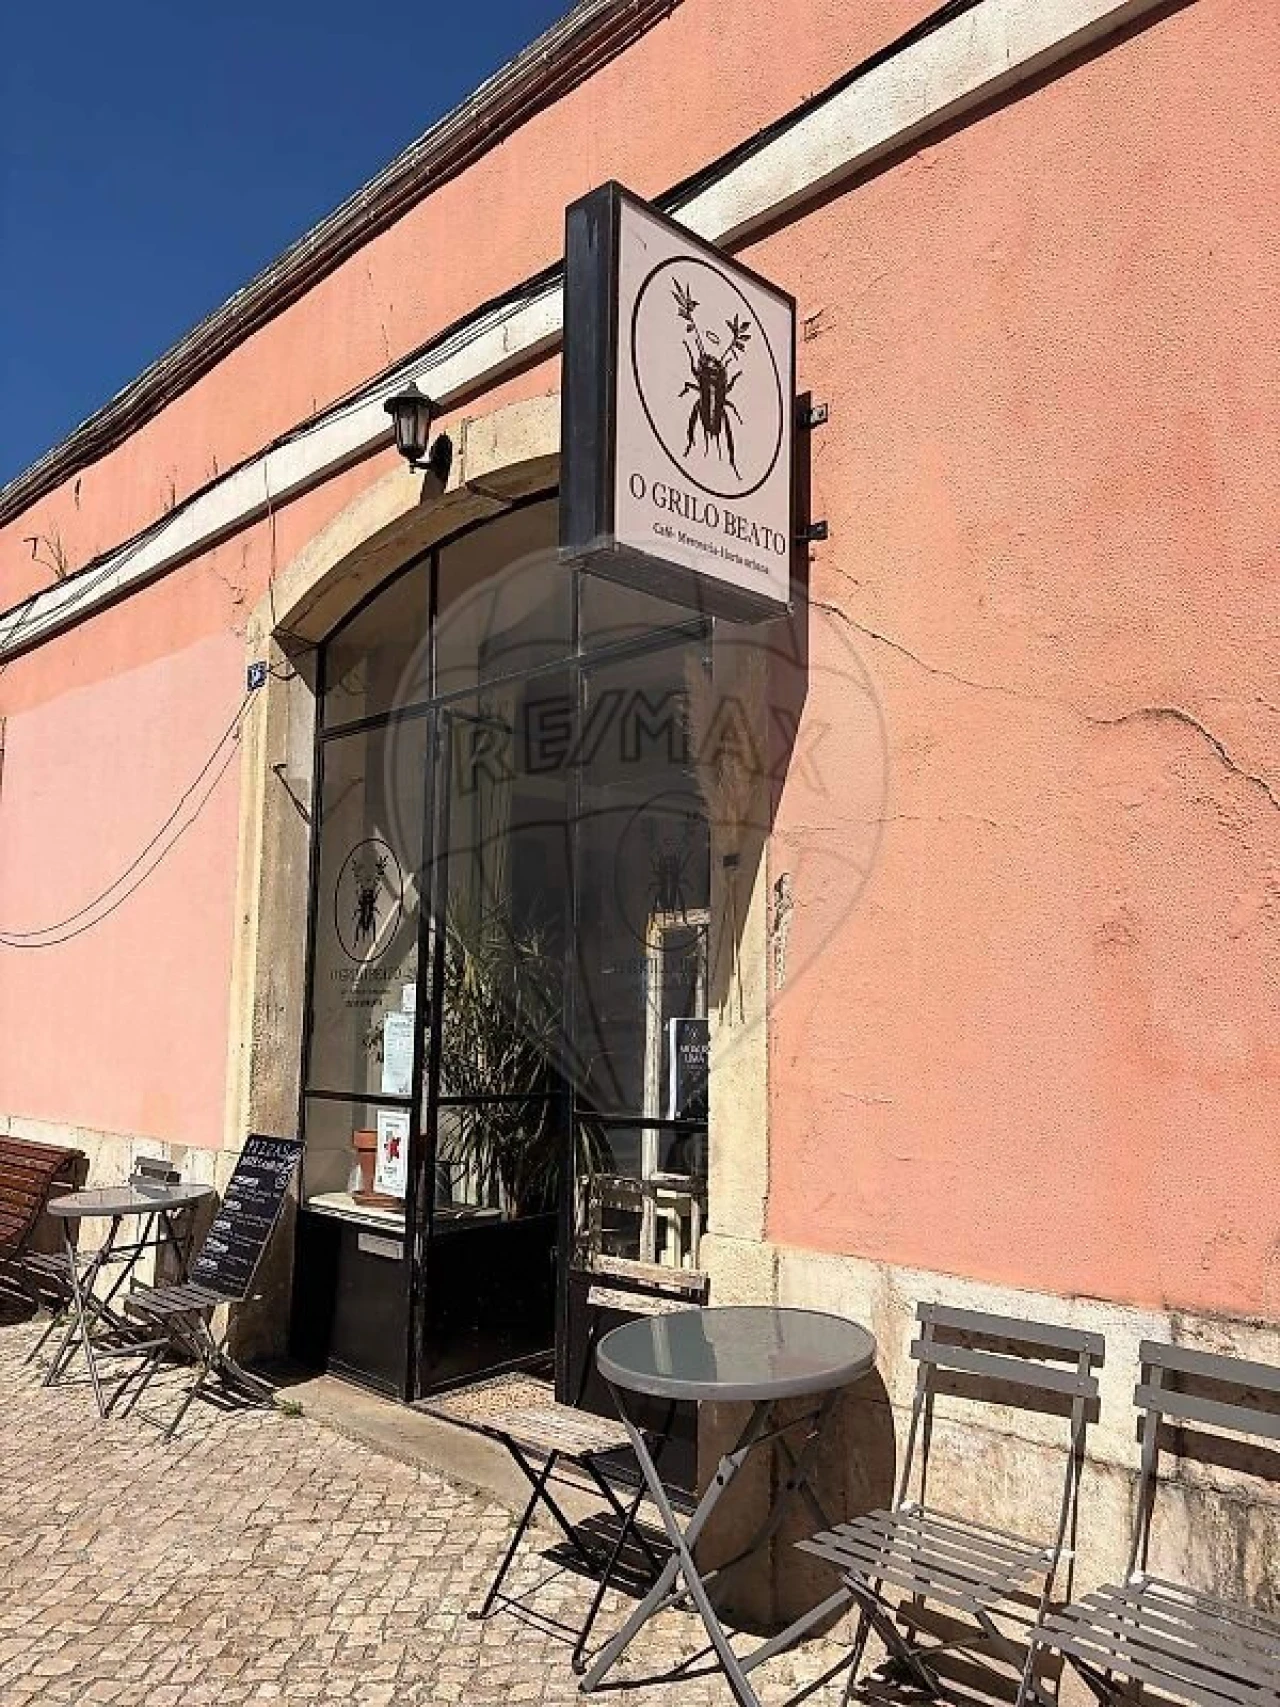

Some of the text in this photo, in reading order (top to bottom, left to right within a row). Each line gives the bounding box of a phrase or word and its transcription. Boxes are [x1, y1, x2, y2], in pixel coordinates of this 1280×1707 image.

[629, 473, 786, 556] O GRILO BEATO
